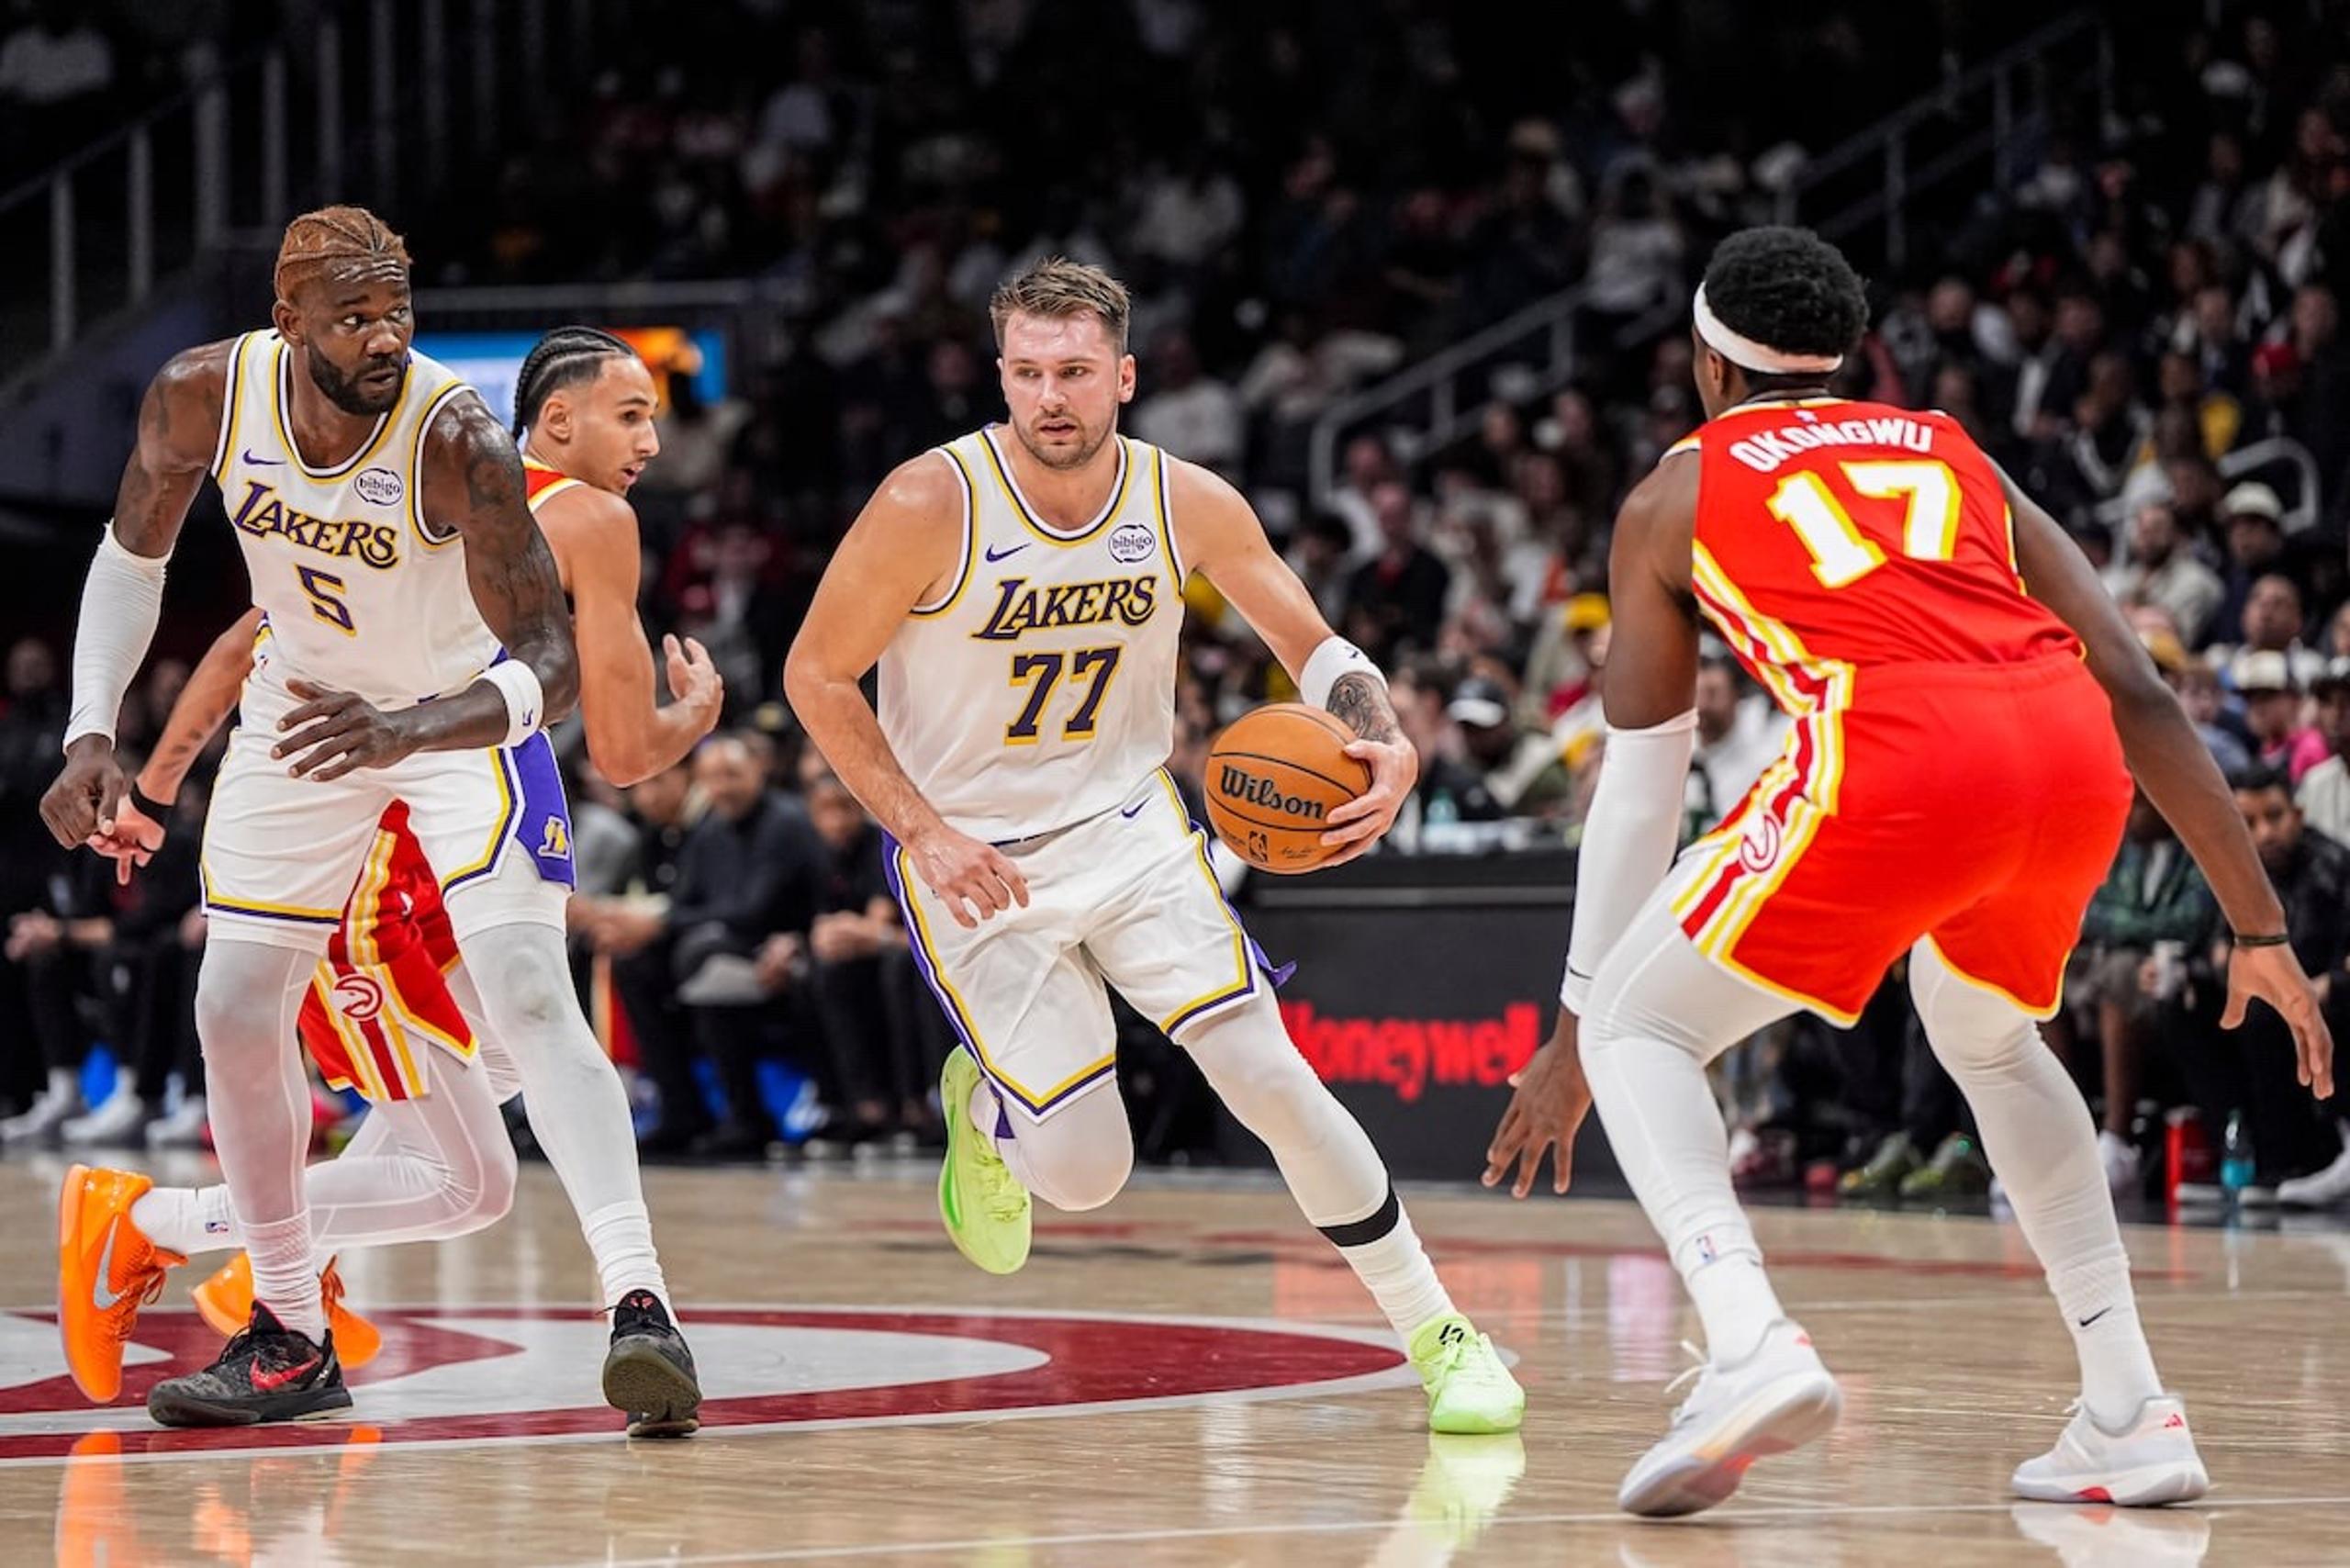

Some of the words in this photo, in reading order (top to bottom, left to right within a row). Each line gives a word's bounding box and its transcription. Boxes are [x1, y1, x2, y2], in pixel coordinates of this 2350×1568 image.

[1729, 418, 1933, 472] OKONGWU
[233, 478, 400, 571] LAKERS
[1765, 459, 1964, 589] 17
[294, 563, 357, 638] 5
[969, 574, 1159, 642] LAKERS
[1004, 642, 1125, 745] 77
[1220, 764, 1324, 820] Wilson
